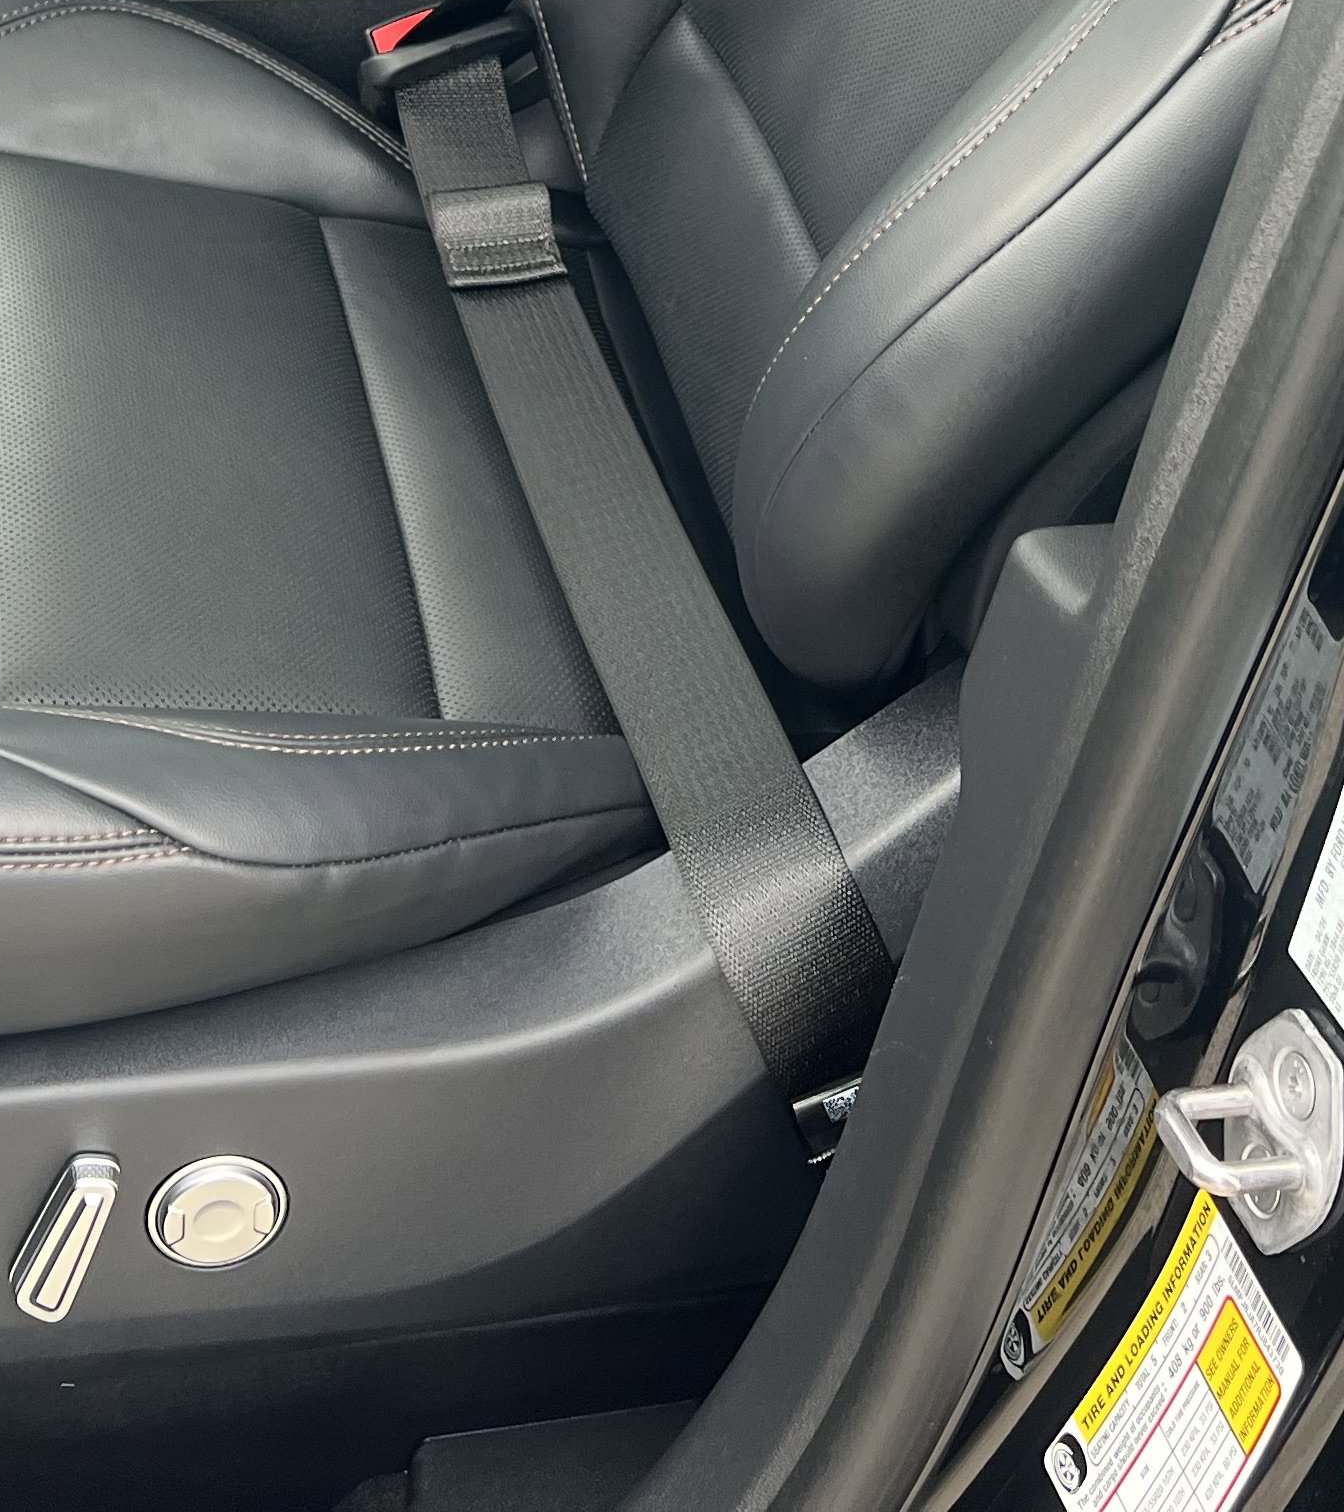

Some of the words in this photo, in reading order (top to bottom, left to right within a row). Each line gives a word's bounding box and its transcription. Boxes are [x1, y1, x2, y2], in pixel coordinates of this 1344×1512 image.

[1313, 872, 1331, 911] MFD.
[1323, 856, 1337, 881] BY
[1080, 1392, 1106, 1433] TIRE
[1103, 1361, 1126, 1399] AND
[1123, 1299, 1164, 1368] LOADING
[1161, 1199, 1211, 1304] INFORMATION
[1166, 1351, 1183, 1382] 408
[1180, 1333, 1195, 1358] kg
[1197, 1292, 1214, 1322] 900
[1210, 1269, 1226, 1298] lbs.
[1204, 1355, 1219, 1382] SEE
[1214, 1315, 1239, 1363] OWNERS
[1214, 1354, 1241, 1402] MANUAL
[1235, 1335, 1251, 1362] FOR
[1227, 1357, 1261, 1421] ADDITIONAL
[1107, 1395, 1131, 1434] CAPACITY
[1237, 1372, 1275, 1445] INFORMATION
[1076, 1490, 1090, 1512] The
[1087, 1454, 1114, 1498] combined
[1112, 1429, 1132, 1461] weight
[1102, 1465, 1119, 1497] cargo
[1116, 1439, 1135, 1474] should
[1133, 1420, 1149, 1448] never
[1146, 1391, 1166, 1426] exceed
